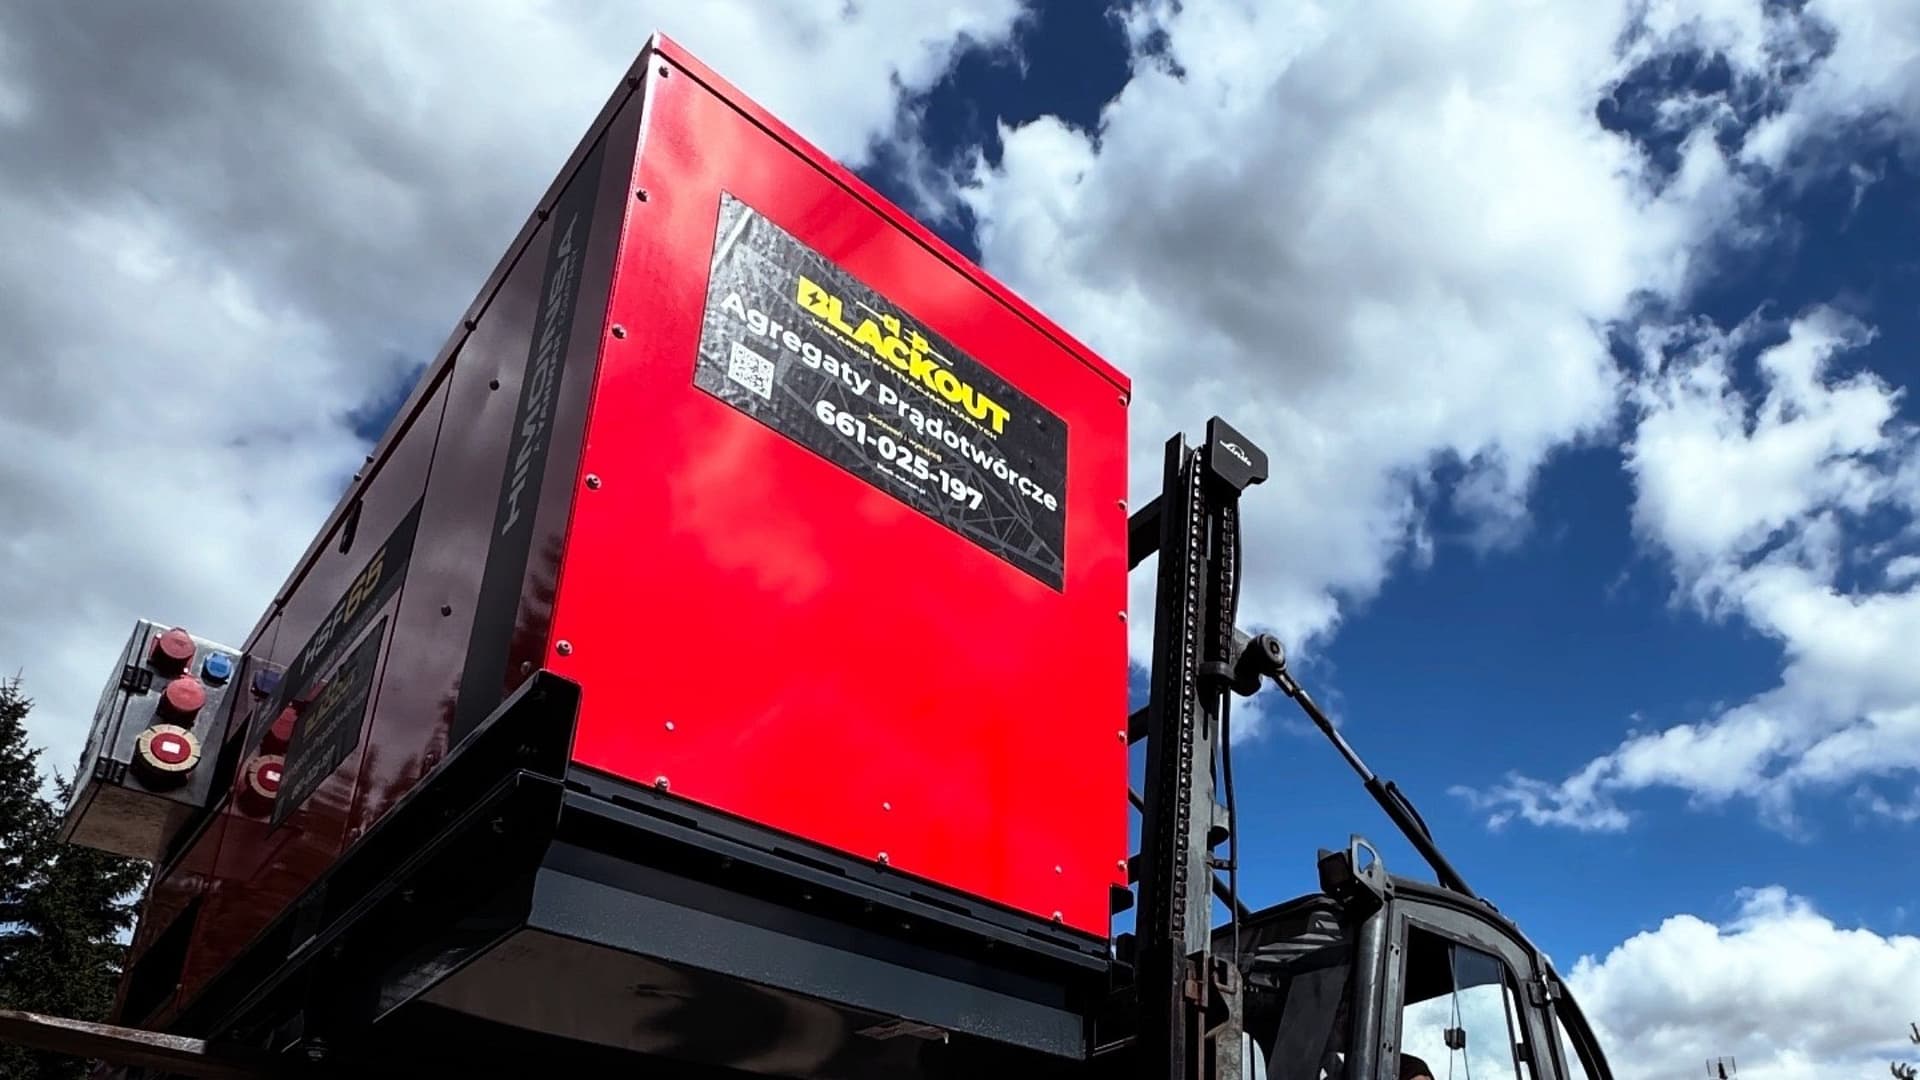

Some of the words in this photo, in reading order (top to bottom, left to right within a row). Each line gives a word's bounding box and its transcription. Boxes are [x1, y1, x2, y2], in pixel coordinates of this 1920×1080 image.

[502, 212, 578, 536] HIMOINSA
[720, 292, 872, 397] Agregaty
[878, 382, 1058, 513] Prądotwórcze
[797, 275, 1010, 435] BLACKOUT
[815, 400, 984, 511] 661-025-197
[300, 547, 386, 675] HSF65
